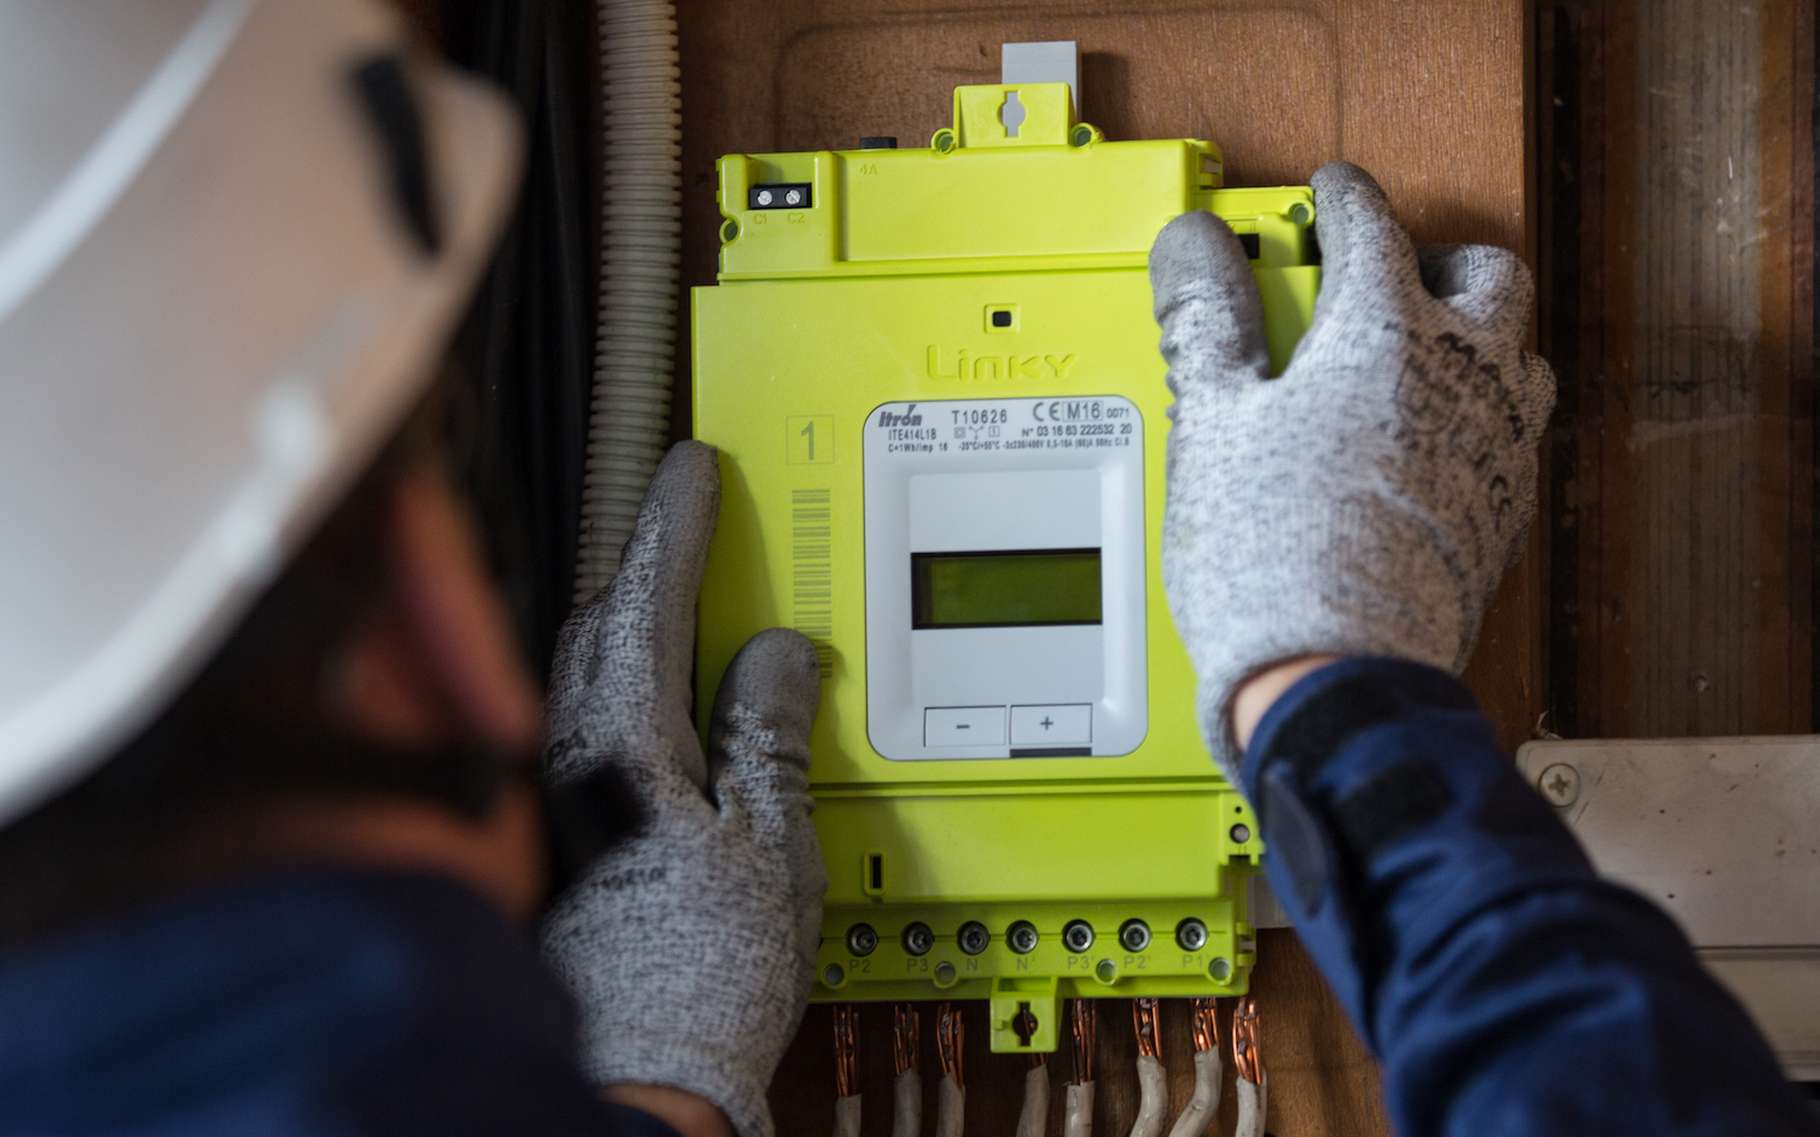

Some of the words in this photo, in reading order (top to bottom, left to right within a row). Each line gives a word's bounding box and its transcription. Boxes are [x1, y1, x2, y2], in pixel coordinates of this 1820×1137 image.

[754, 214, 768, 224] C1
[787, 213, 806, 224] C2
[1067, 402, 1101, 419] M16
[1106, 408, 1130, 418] 0071
[1036, 426, 1049, 436] 03
[1052, 425, 1063, 436] 16
[1120, 423, 1133, 434] 20
[800, 420, 815, 461] 1
[848, 959, 871, 973] P2
[906, 958, 928, 972] P3
[966, 958, 979, 971] N
